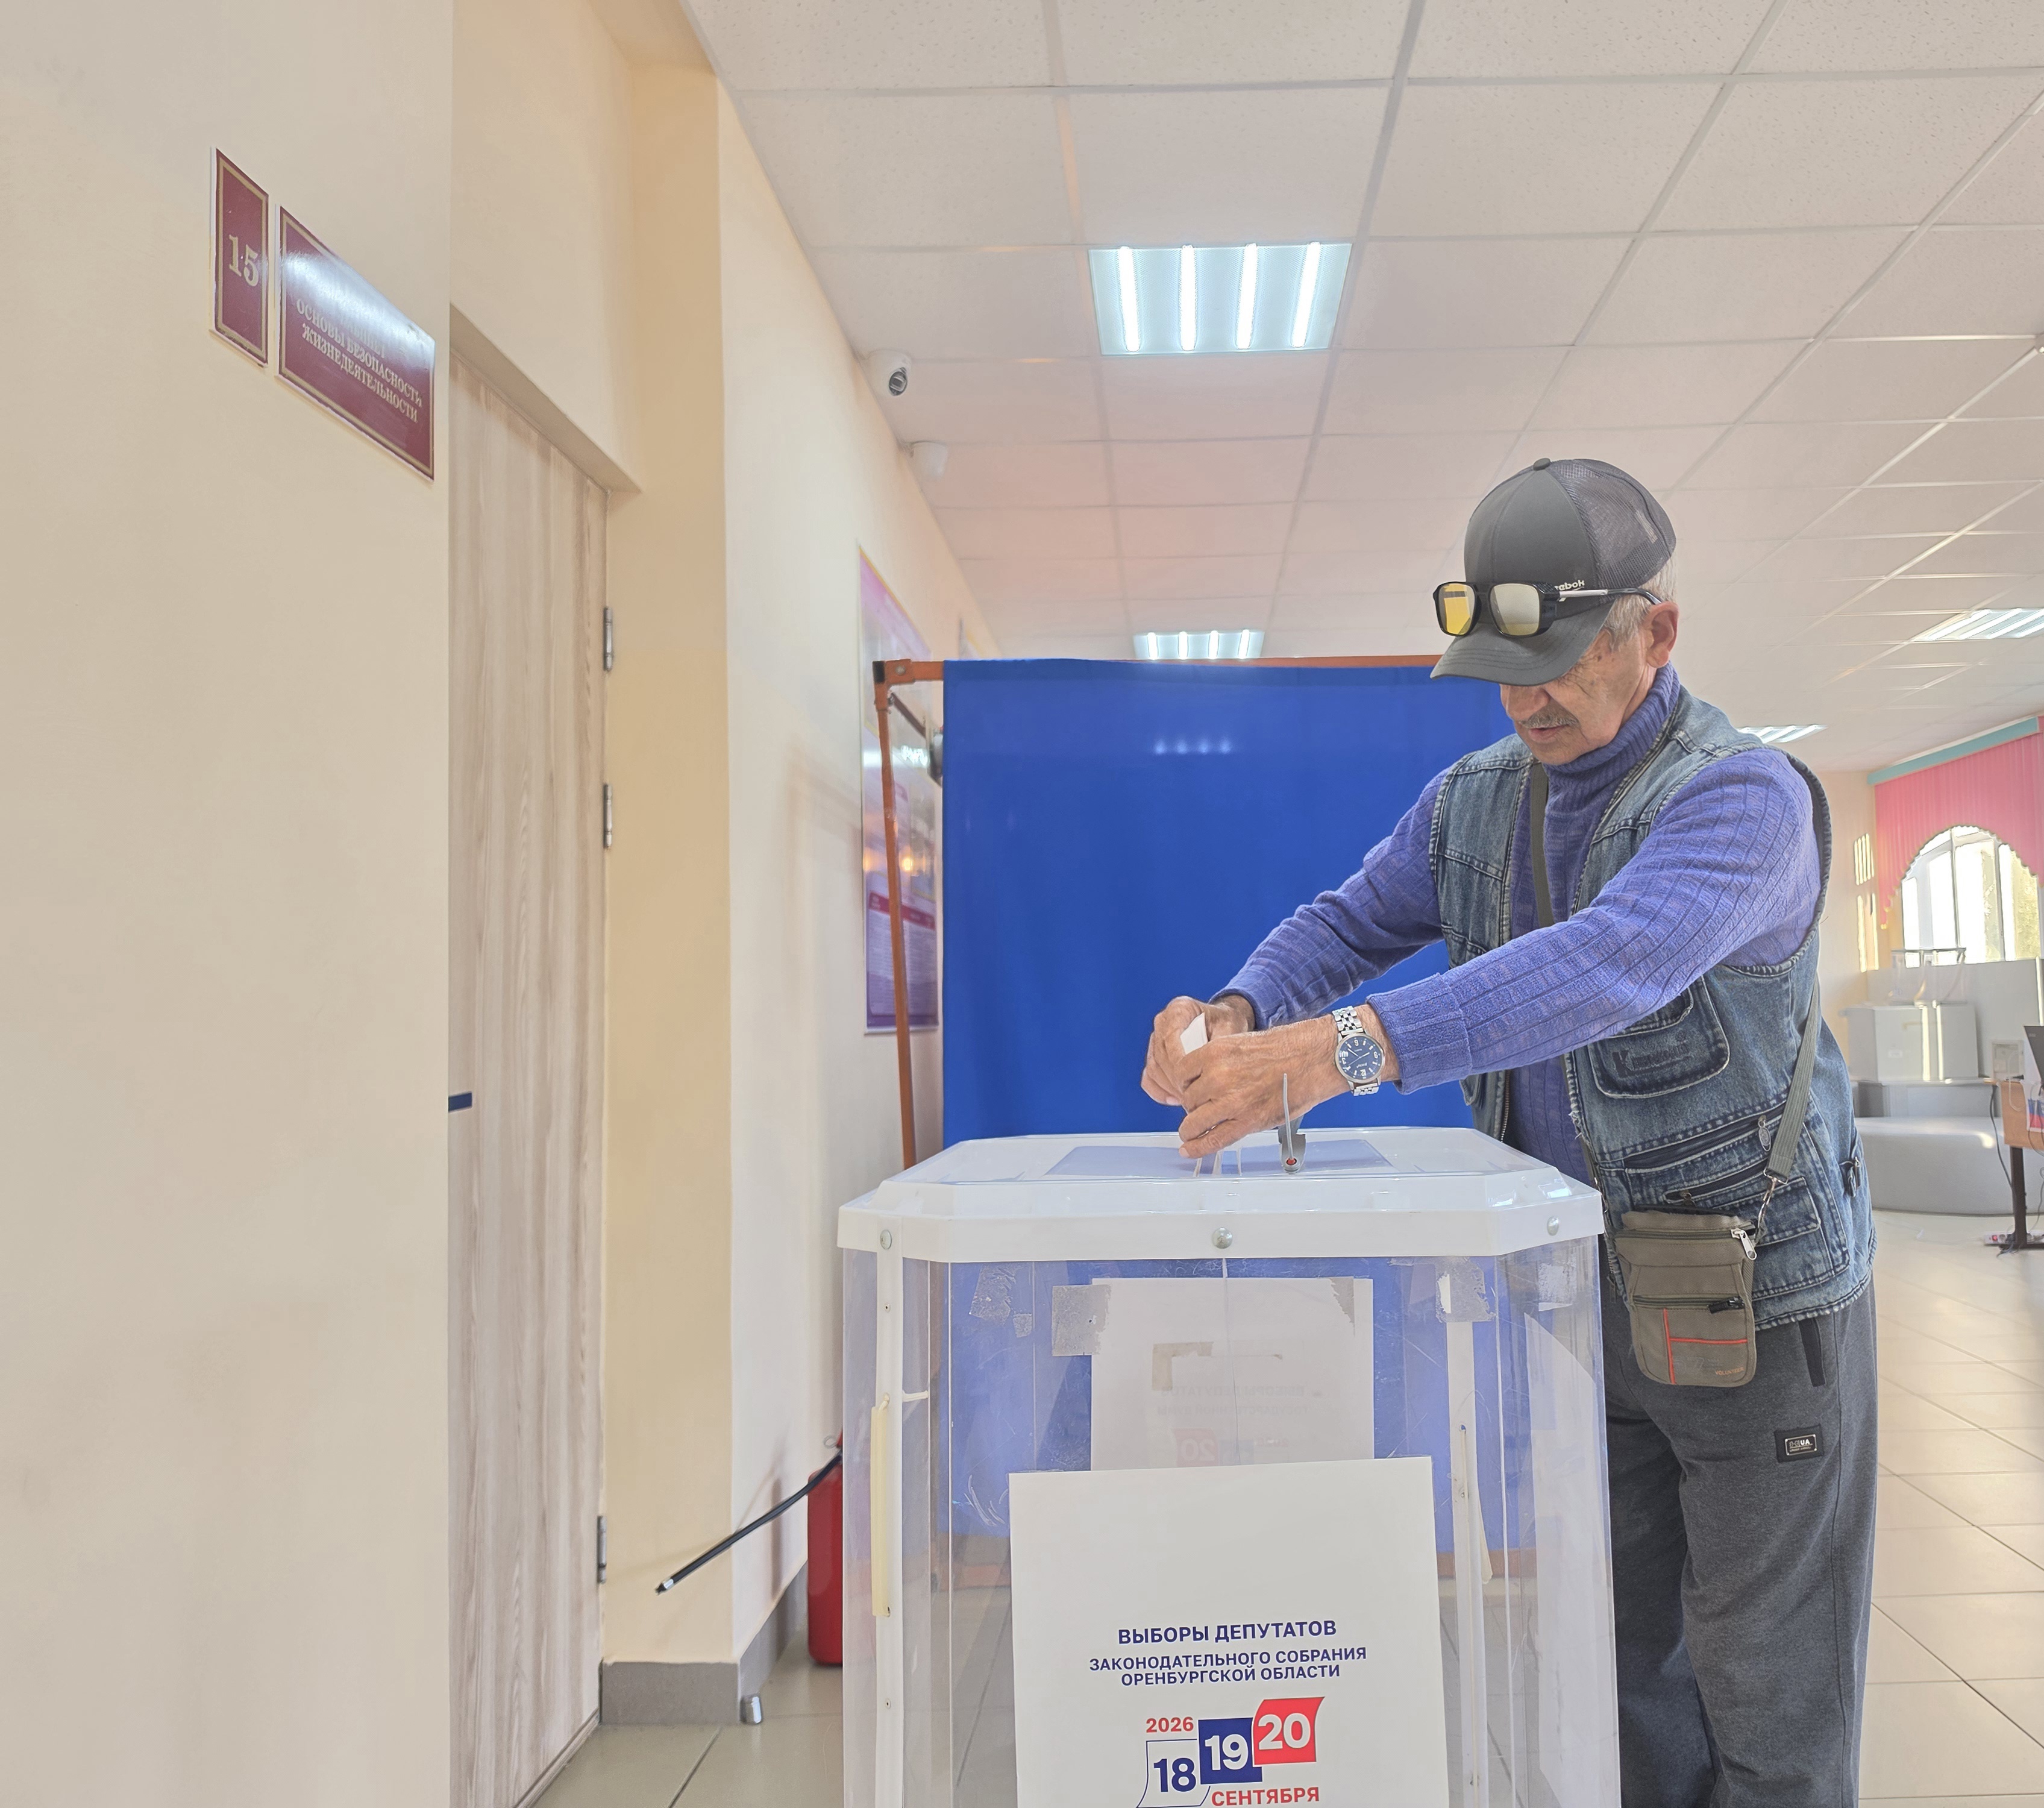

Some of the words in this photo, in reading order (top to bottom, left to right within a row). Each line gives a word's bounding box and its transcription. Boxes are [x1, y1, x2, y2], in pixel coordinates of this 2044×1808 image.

[229, 234, 259, 286] 15
[296, 299, 345, 348] ОСНОВЫ
[346, 337, 422, 407] БЕЗОПАСНОСТИ
[303, 323, 418, 423] ЖИЗНЕДЕЯТЕЛЬНОСТИ
[1555, 579, 1585, 591] ebok
[1118, 1626, 1209, 1645] ВЫБОРЫ
[1215, 1620, 1337, 1643] ДЕПУТАТОВ
[1089, 1651, 1271, 1671] ЗАКОНОДАТЕЛЬНОГО
[1276, 1647, 1367, 1663] СОБРАНИЯ
[1121, 1665, 1256, 1686] ОРЕНБУРГСКОЙ
[1261, 1665, 1340, 1680] ОБЛАСТИ
[1146, 1717, 1194, 1733] 2026
[1258, 1713, 1311, 1750] 20
[1205, 1734, 1249, 1771] 19
[1153, 1757, 1197, 1792] 18
[1211, 1786, 1320, 1806] СЕНТЯБРЯ
